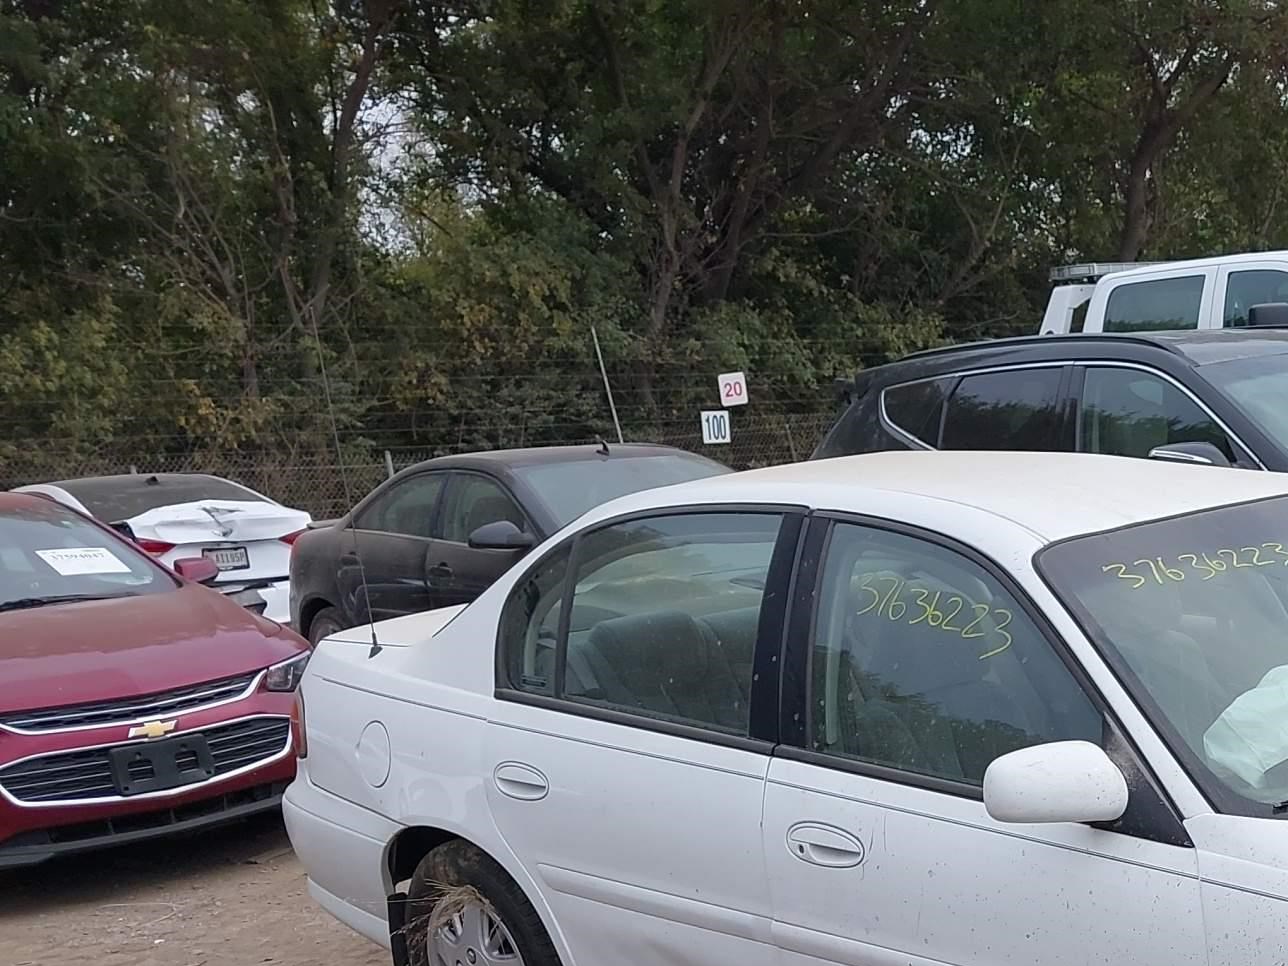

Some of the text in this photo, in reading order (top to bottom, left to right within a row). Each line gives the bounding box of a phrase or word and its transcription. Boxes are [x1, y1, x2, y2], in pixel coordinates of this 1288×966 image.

[724, 381, 742, 398] 20
[705, 414, 727, 440] 100
[856, 571, 1014, 660] 37636223
